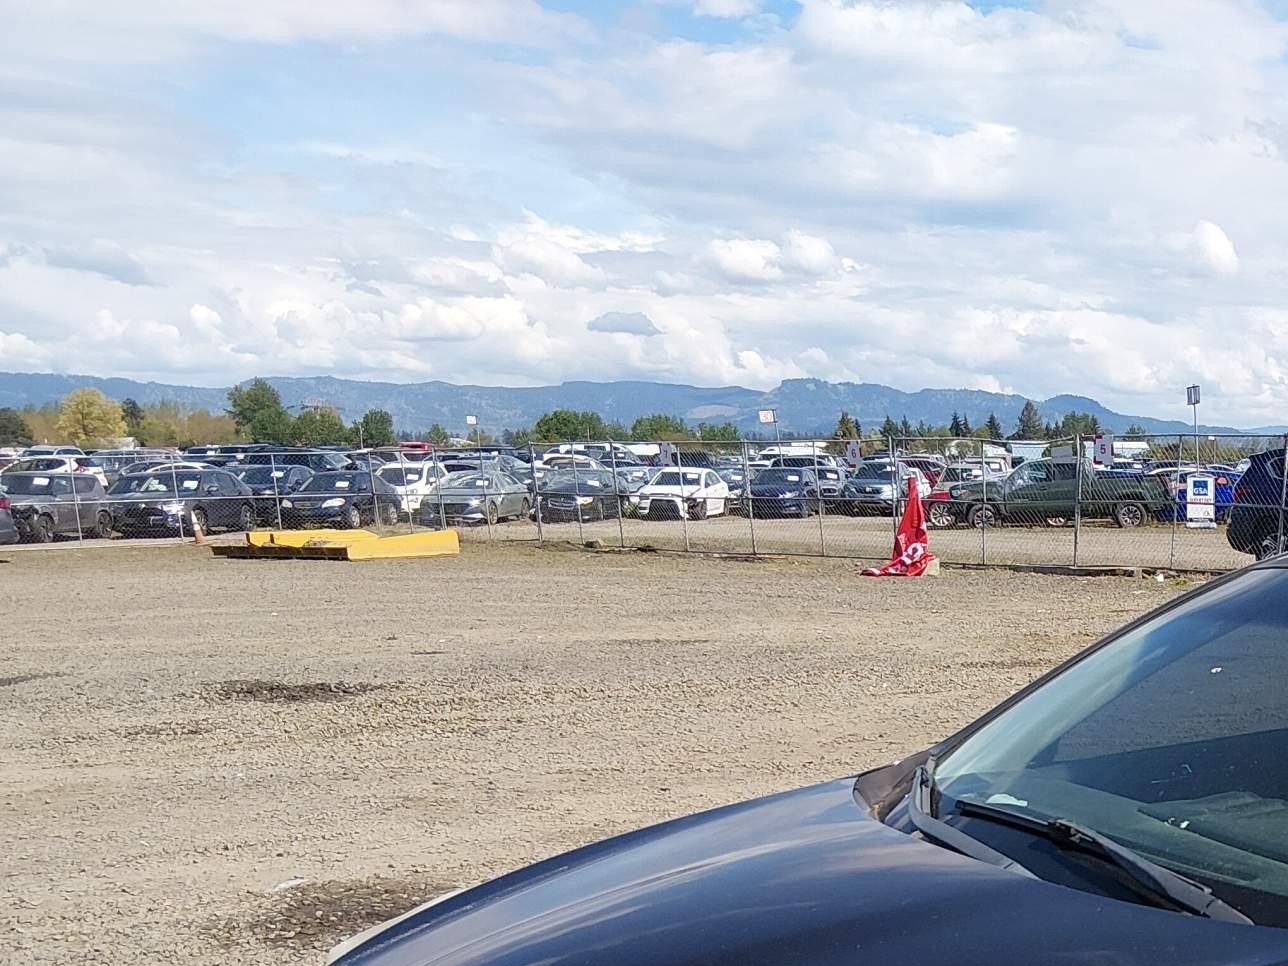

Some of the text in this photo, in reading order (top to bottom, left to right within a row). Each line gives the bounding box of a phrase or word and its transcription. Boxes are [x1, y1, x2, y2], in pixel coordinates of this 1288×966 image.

[850, 448, 857, 459] 6
[1099, 443, 1107, 454] 5
[1193, 487, 1208, 496] GSA
